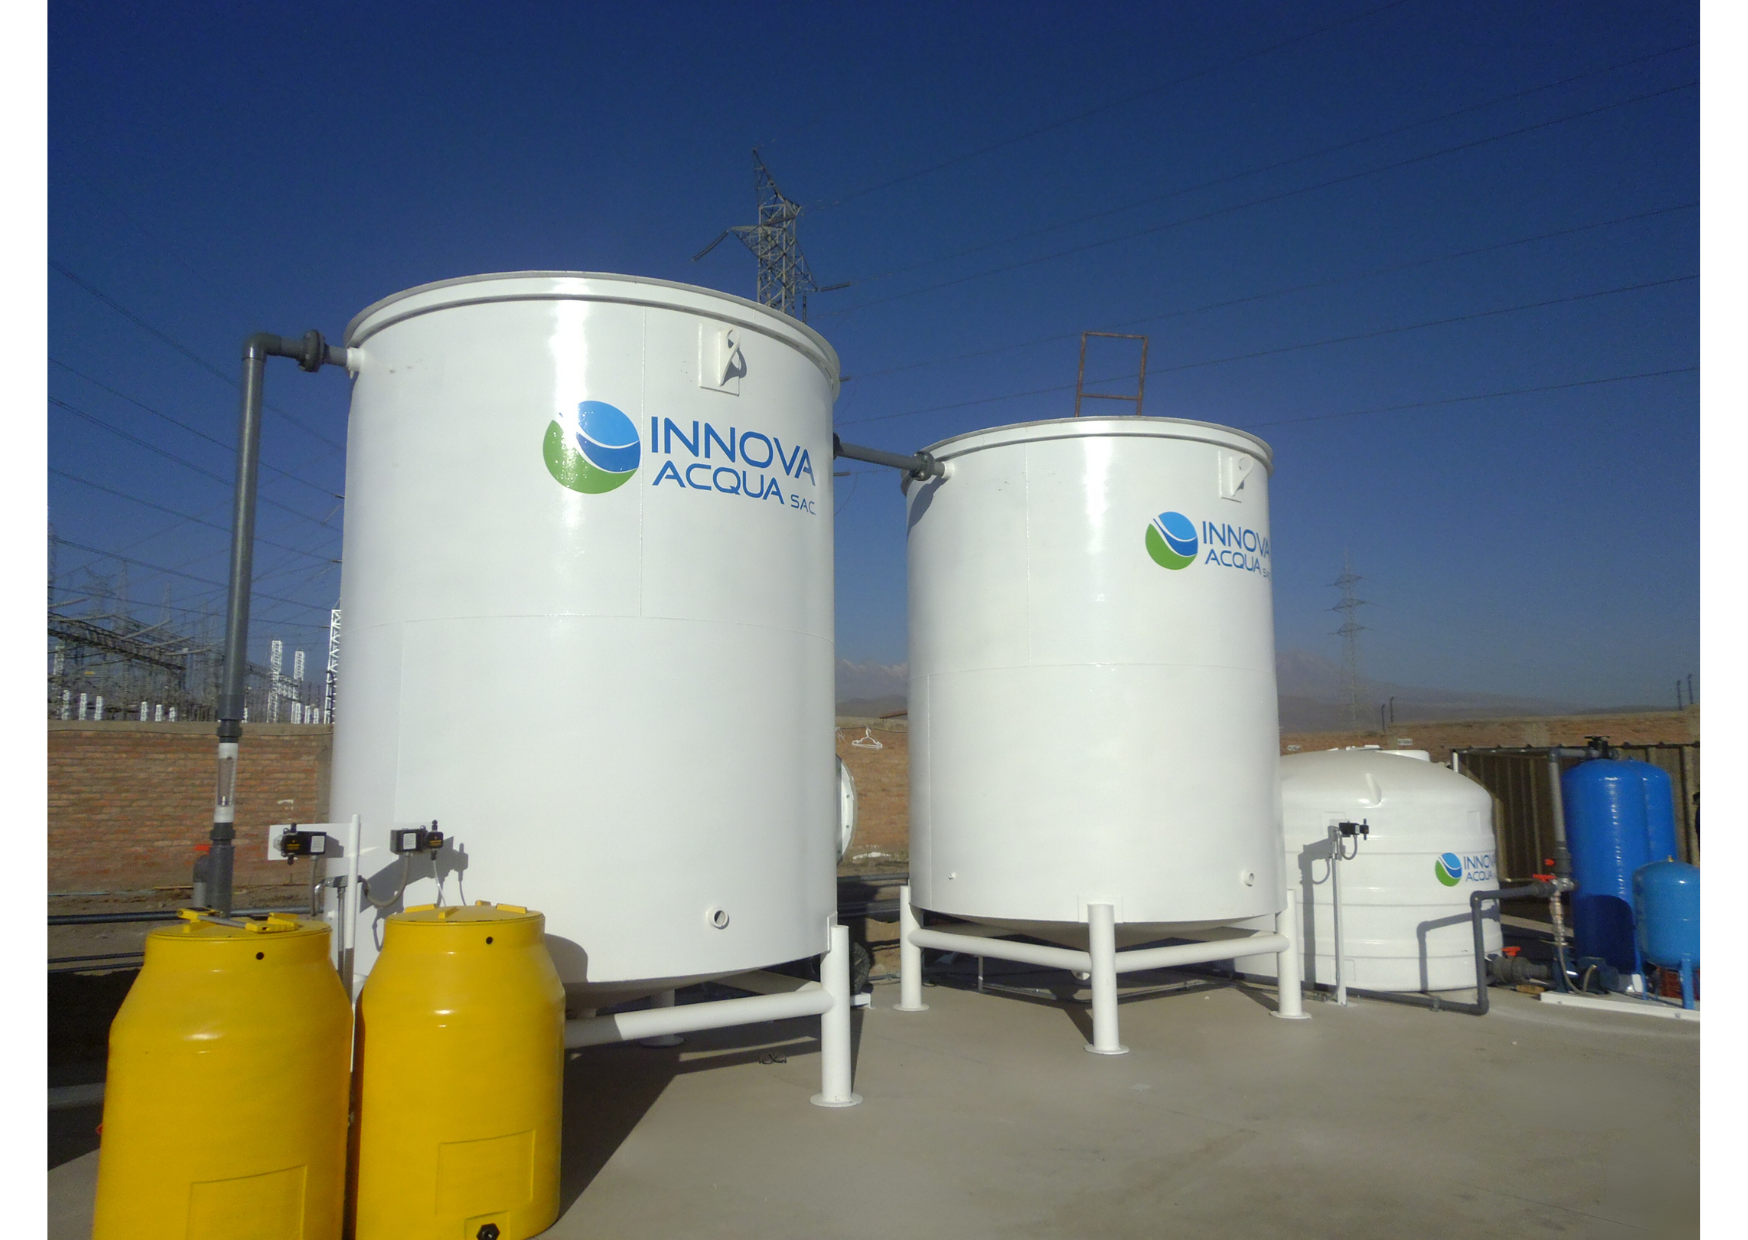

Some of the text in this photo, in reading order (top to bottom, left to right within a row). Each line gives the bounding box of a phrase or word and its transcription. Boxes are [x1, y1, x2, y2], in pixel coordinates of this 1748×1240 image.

[651, 416, 816, 486] INNOVA
[652, 460, 785, 505] ACQUA
[1202, 520, 1270, 558] INNOVA
[1204, 548, 1262, 575] ACQUA
